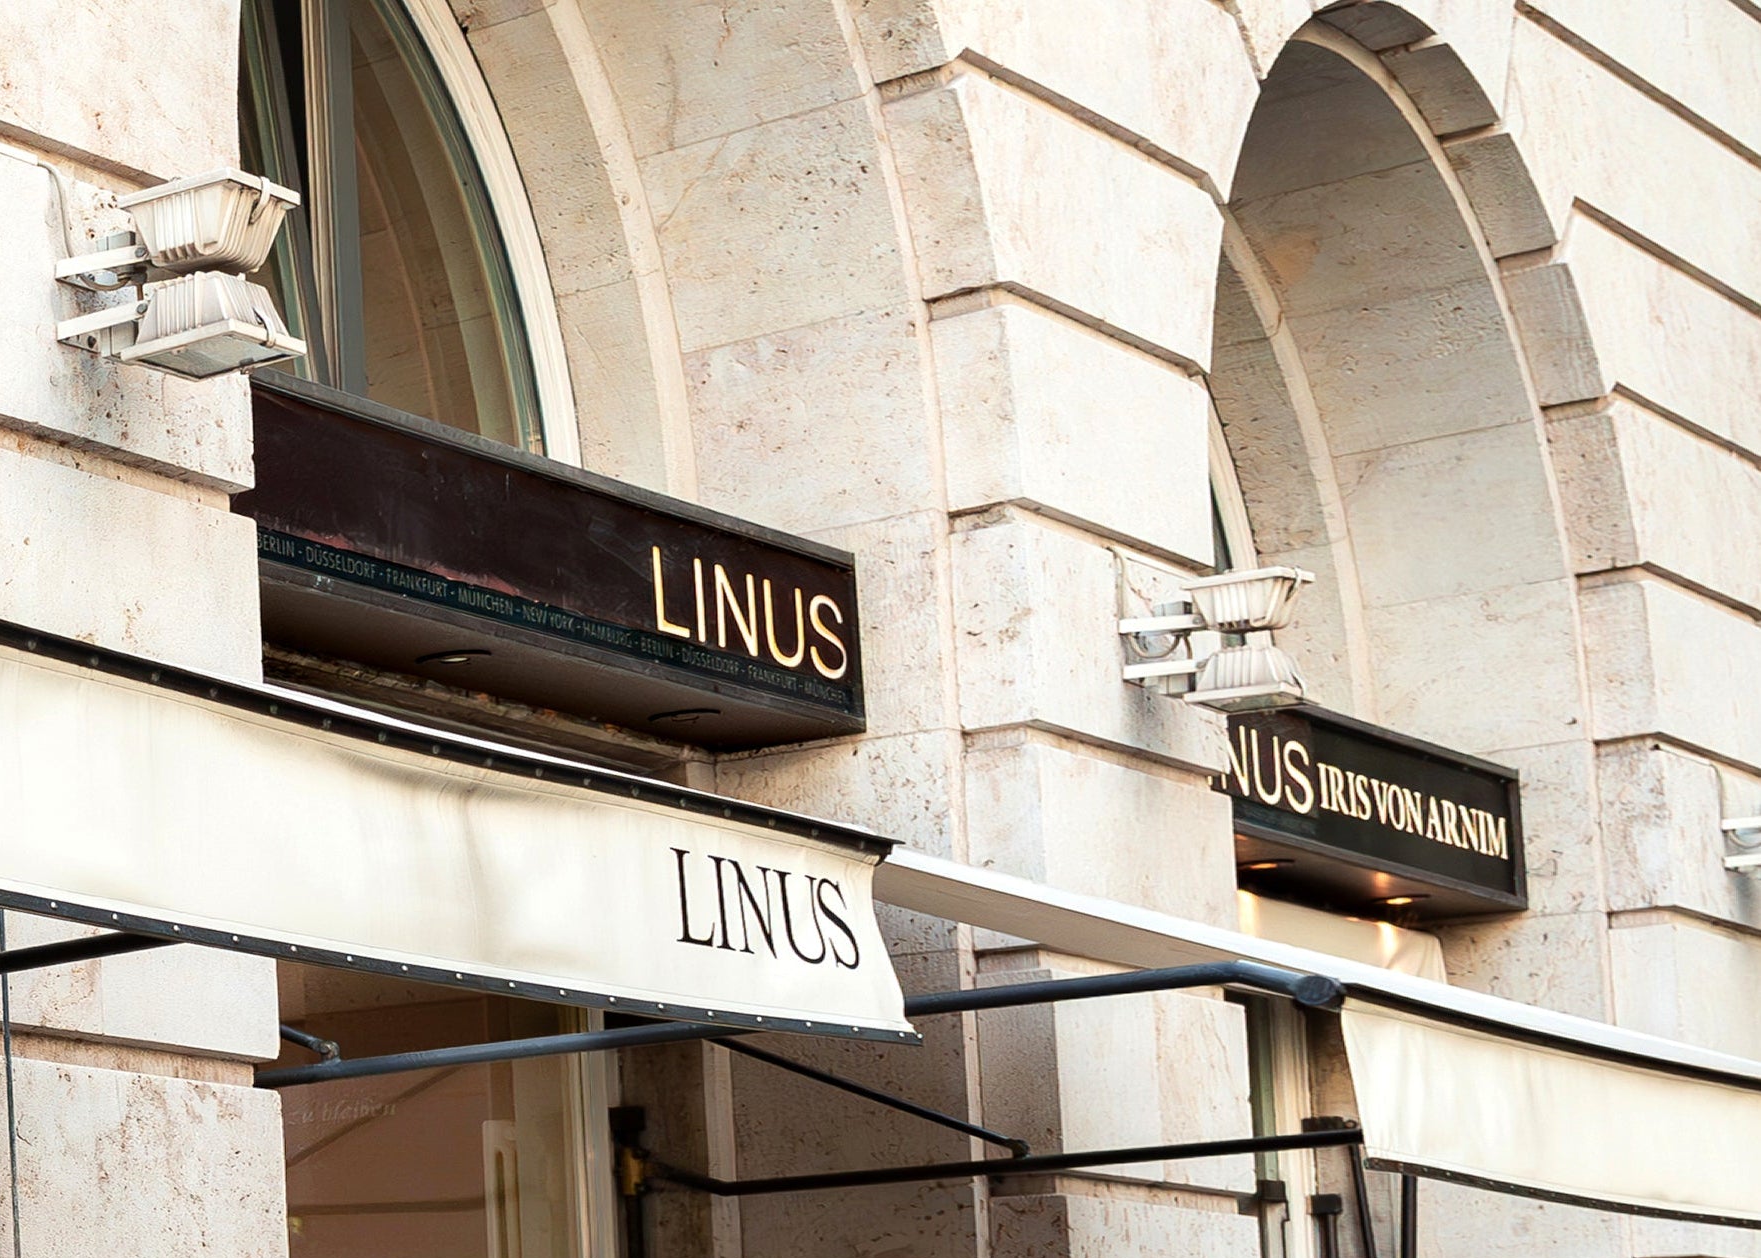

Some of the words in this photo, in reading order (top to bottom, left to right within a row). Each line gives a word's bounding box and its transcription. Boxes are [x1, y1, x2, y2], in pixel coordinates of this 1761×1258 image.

[257, 532, 296, 558] BERLIN
[305, 543, 376, 580] DÜSSELDORF
[385, 567, 448, 599] FRANKFURT
[457, 585, 514, 617] MÜNCHEN
[521, 604, 548, 624] NEW
[652, 546, 847, 678] LINUS
[1208, 725, 1315, 815] NUS
[1316, 763, 1372, 821] IRIS
[1370, 778, 1426, 837] VON
[1425, 795, 1509, 860] ARNIM
[670, 847, 860, 969] LINUS
